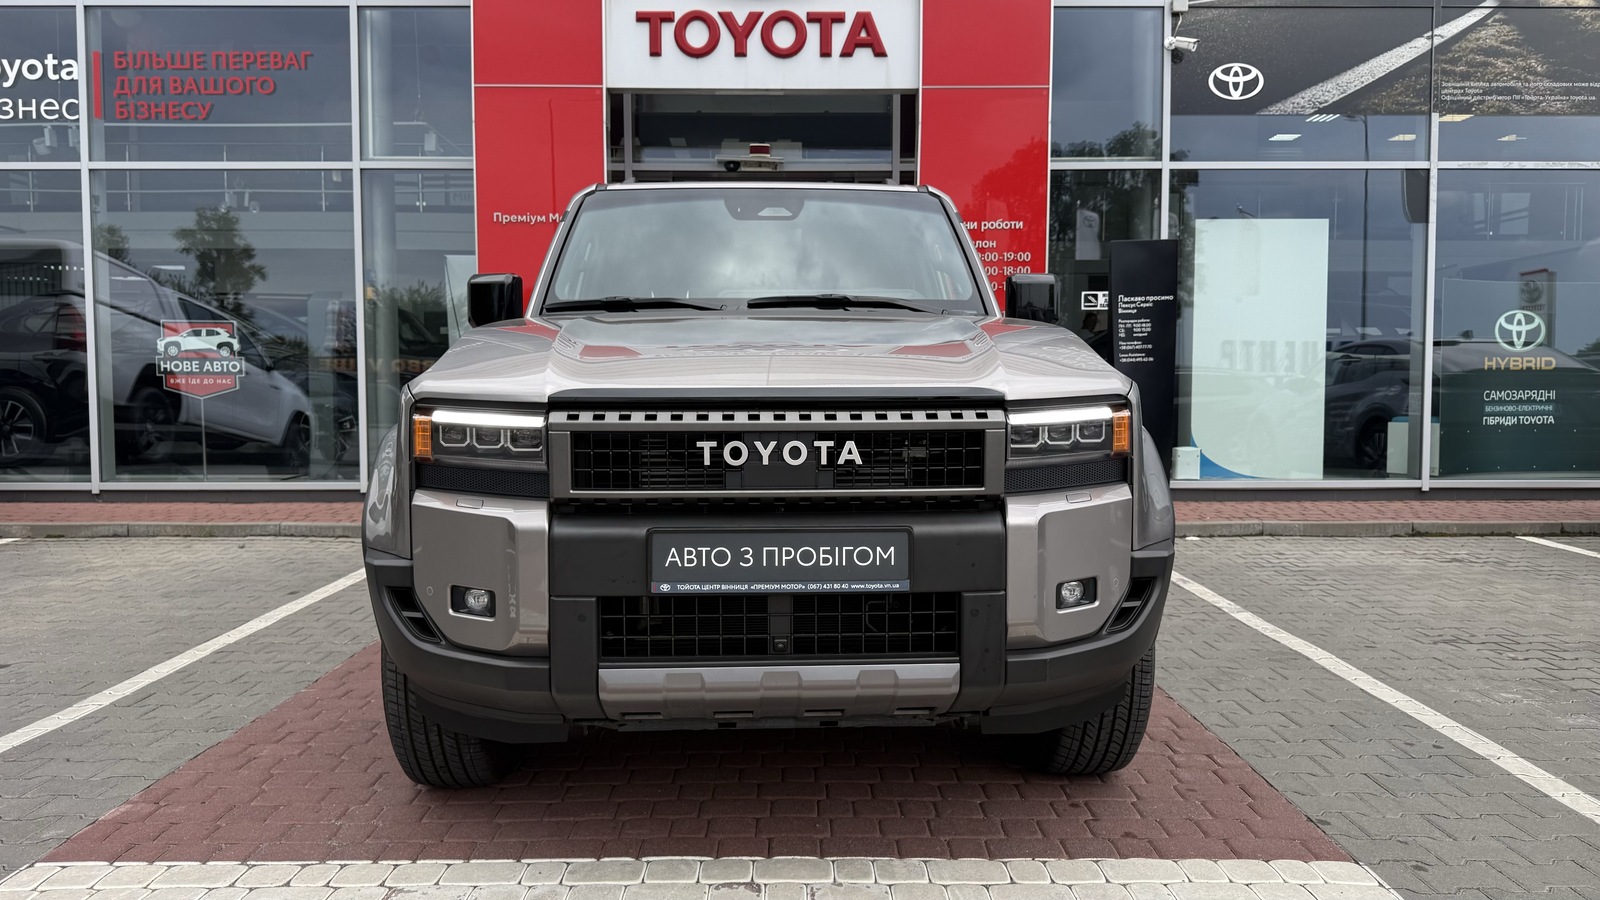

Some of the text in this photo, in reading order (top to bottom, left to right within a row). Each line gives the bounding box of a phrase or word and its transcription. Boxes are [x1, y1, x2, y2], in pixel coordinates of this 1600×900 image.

[636, 9, 888, 59] TOYOTA
[113, 51, 312, 70] БІЛЬШЕ ПЕРЕВАГ
[0, 53, 79, 88] yota
[113, 76, 276, 98] ДЛЯ ВАШОГО
[0, 98, 80, 120] знес
[115, 101, 212, 120] БІЗНЕСУ
[493, 212, 563, 225] Преміум М
[981, 219, 1024, 232] роботи
[973, 240, 997, 249] лон
[985, 266, 1031, 276] 00-18:00
[160, 360, 240, 373] НОВЕ АВТО
[1484, 356, 1557, 371] HYBRID
[1483, 390, 1556, 402] САМОЗАРЯДНІ
[1482, 415, 1555, 427] ГІБРИДИ TOYOTA
[696, 440, 863, 466] TOYOTA
[665, 546, 895, 567] АВТО З ПРОБІГОМ
